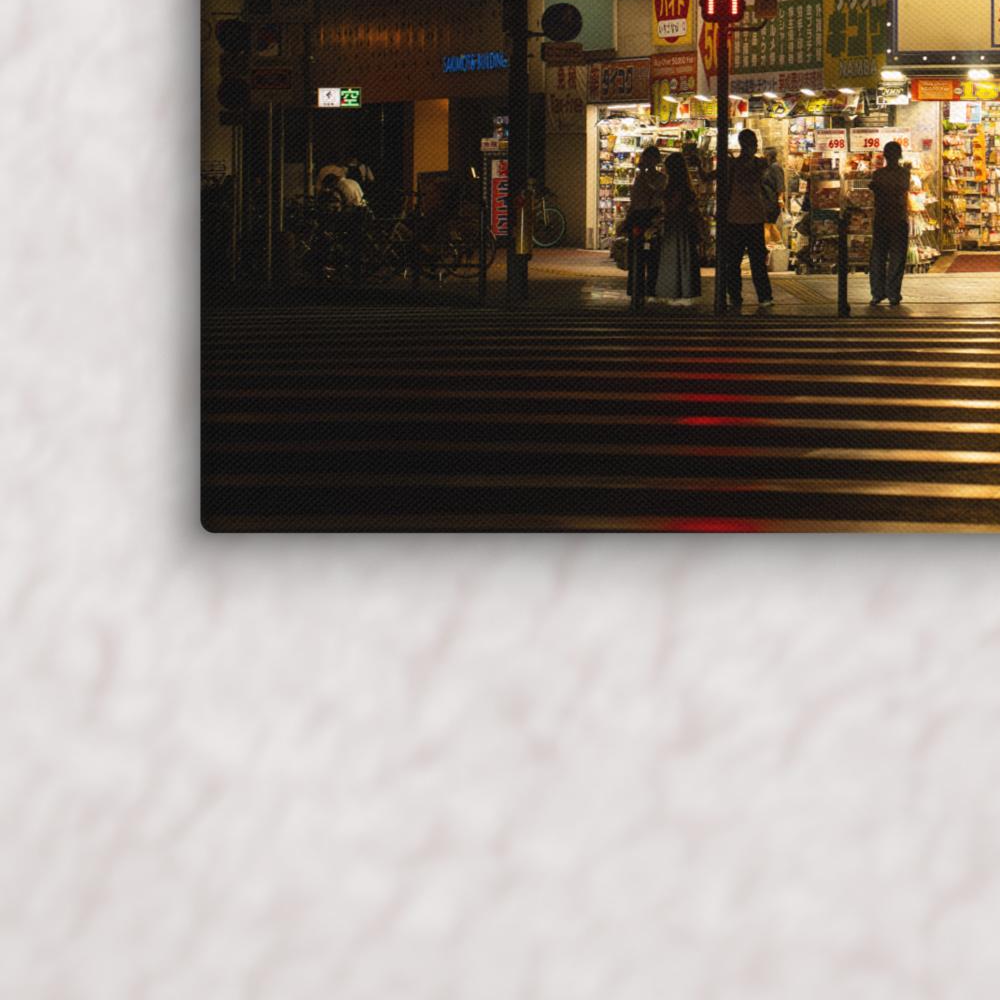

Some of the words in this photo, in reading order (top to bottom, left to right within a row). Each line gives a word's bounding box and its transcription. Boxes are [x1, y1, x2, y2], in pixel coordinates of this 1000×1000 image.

[341, 89, 359, 107] 空
[828, 138, 845, 149] 698
[864, 137, 881, 148] 198
